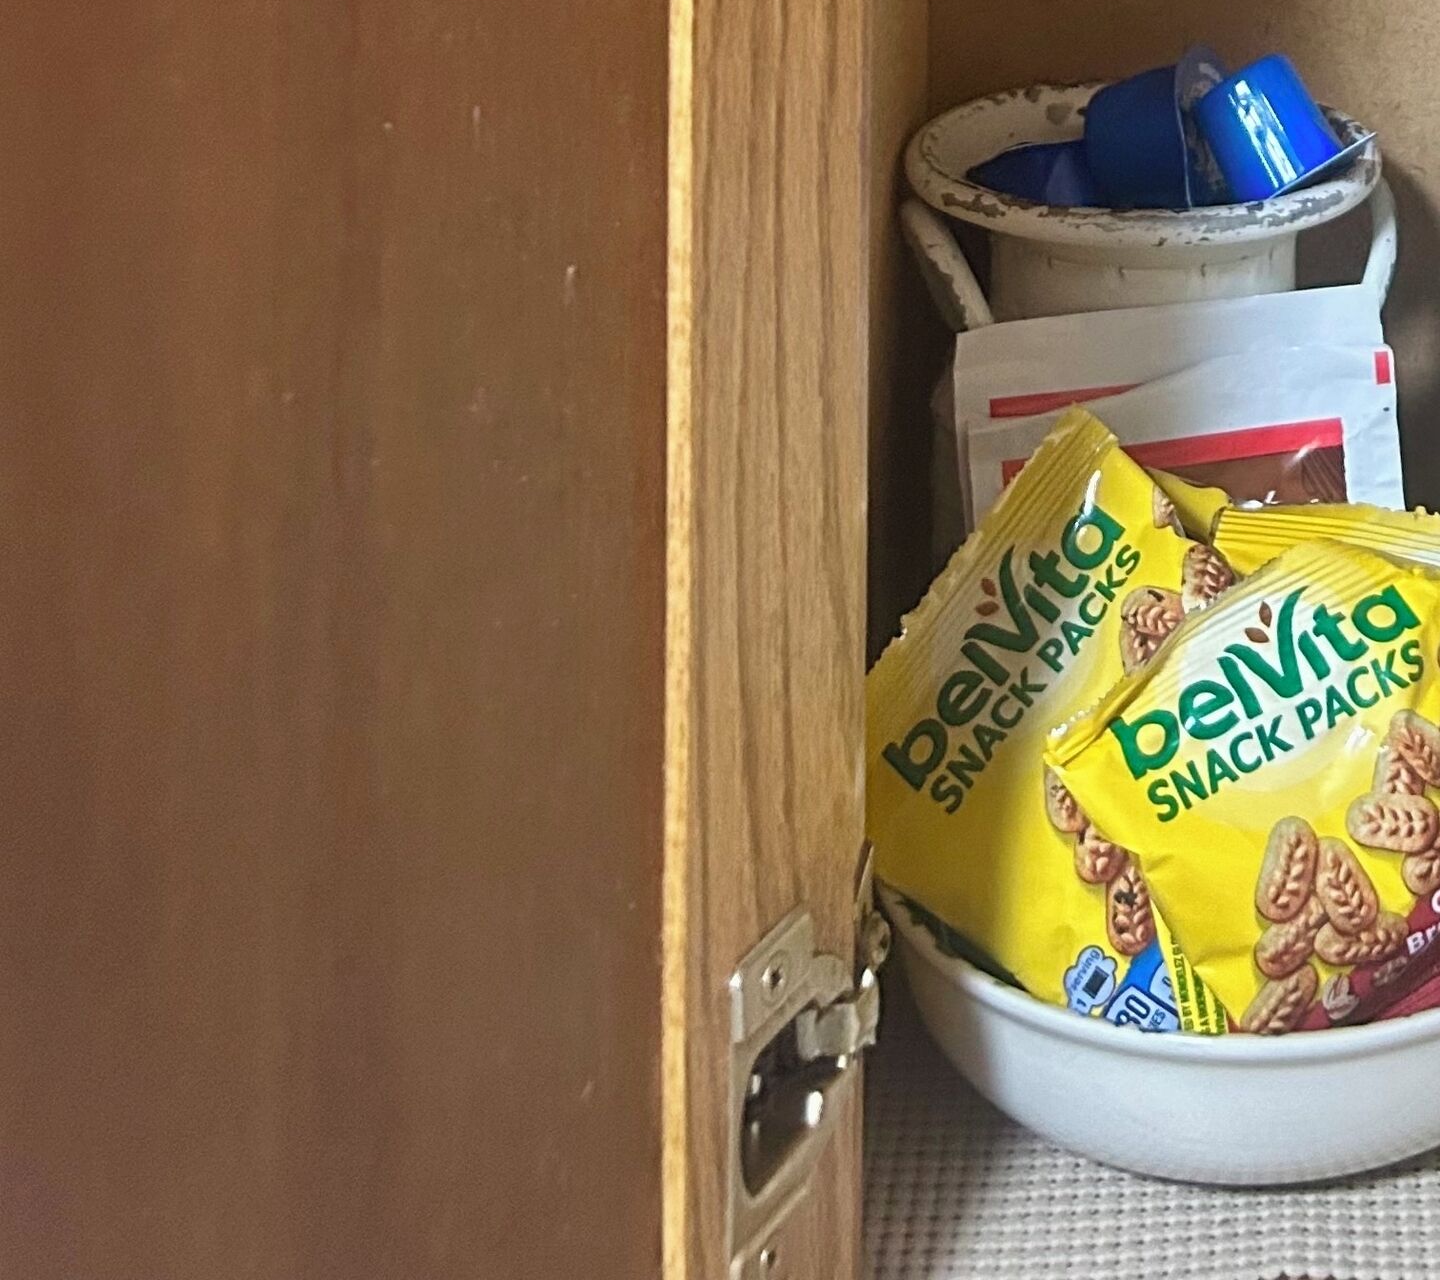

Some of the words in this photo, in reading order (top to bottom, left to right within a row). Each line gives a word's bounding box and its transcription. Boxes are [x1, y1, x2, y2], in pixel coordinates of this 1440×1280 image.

[881, 504, 1126, 792] belVita
[930, 666, 1048, 816] SNACK
[1036, 544, 1141, 674] PACKS
[1109, 584, 1422, 781] belVita
[1147, 714, 1295, 823] SNACK
[1295, 639, 1425, 740] PACKS
